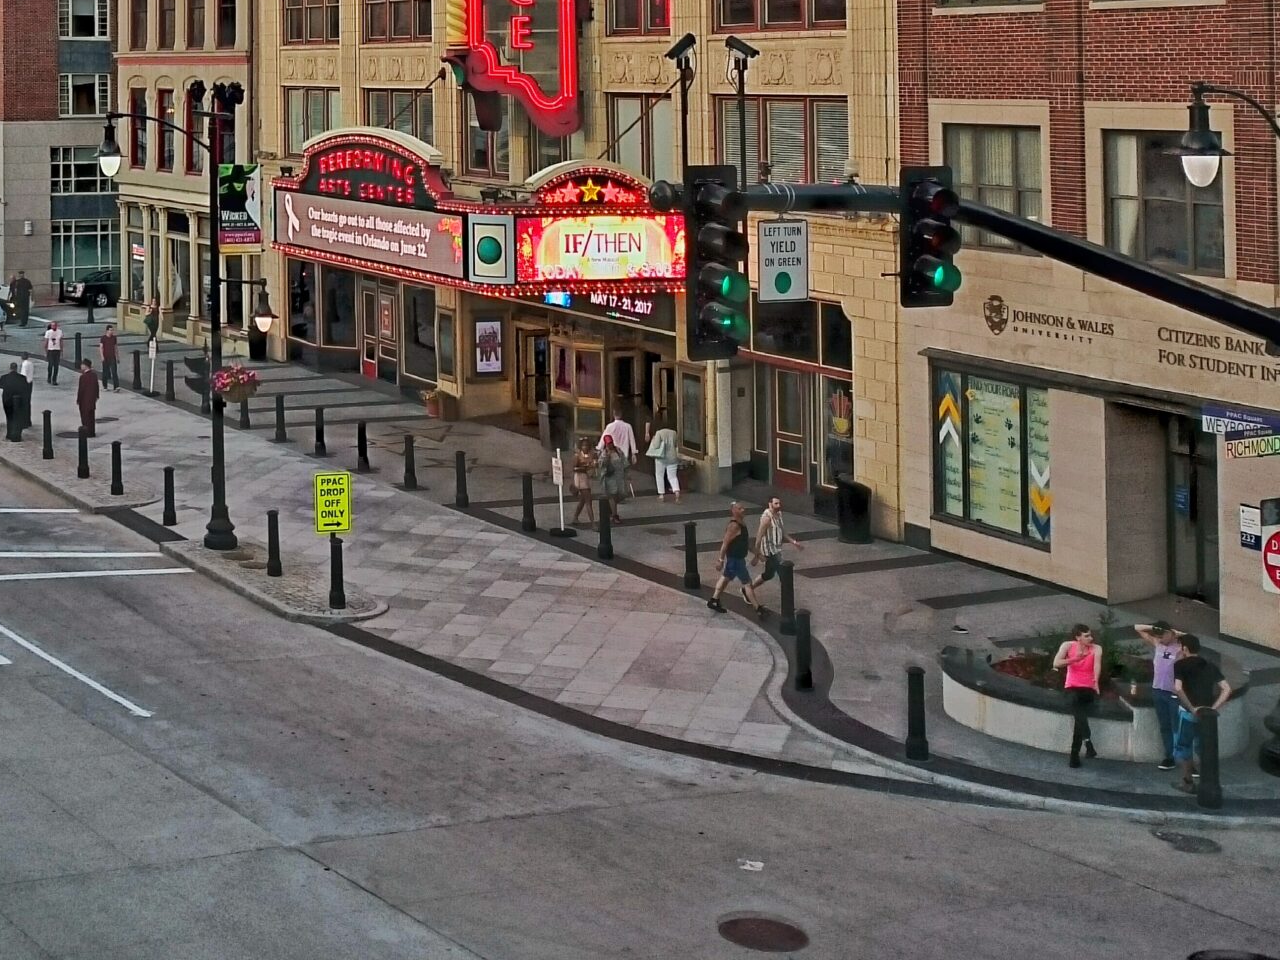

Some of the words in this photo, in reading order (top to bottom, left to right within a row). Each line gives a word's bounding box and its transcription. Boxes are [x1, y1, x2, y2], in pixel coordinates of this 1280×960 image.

[319, 150, 416, 186] PERFORMING
[319, 178, 351, 196] ARTS
[359, 183, 416, 204] CENTER
[308, 207, 321, 220] Our
[321, 208, 338, 223] hearts
[338, 215, 347, 228] go
[347, 214, 358, 227] out
[358, 216, 365, 228] to
[366, 216, 375, 229] all
[375, 217, 393, 232] those
[393, 220, 420, 237] affected
[421, 223, 431, 243] by
[764, 227, 780, 237] LEFT
[783, 226, 802, 236] TURN
[311, 224, 321, 238] the
[321, 227, 338, 244] tragic
[337, 231, 355, 244] event
[355, 231, 362, 245] in
[362, 233, 390, 251] Orlando
[390, 241, 400, 252] on
[400, 239, 417, 256] June
[417, 243, 428, 257] 12.
[564, 229, 642, 257] IF/THEN
[770, 241, 796, 253] YIELD
[764, 258, 774, 267] ON
[778, 257, 802, 267] GREEN
[535, 265, 583, 279] TODAY
[590, 292, 608, 306] MAY
[609, 295, 618, 308] 17
[634, 300, 652, 315] 2017
[1012, 310, 1064, 328] JOHNSON
[1066, 317, 1077, 330] &
[1078, 319, 1115, 337] WALES
[1013, 326, 1094, 344] UNIVERSITY
[1157, 326, 1221, 350] CITIZENS
[1225, 336, 1266, 356] BANK
[1158, 348, 1186, 368] FOR
[1188, 354, 1258, 380] STUDENT
[1226, 411, 1242, 419] PPAC
[1226, 437, 1280, 458] RICHMOND
[321, 477, 345, 486] PPAC
[320, 488, 345, 497] DROP
[324, 499, 341, 508] OFF
[321, 509, 345, 518] ONLY
[1241, 532, 1256, 543] 232
